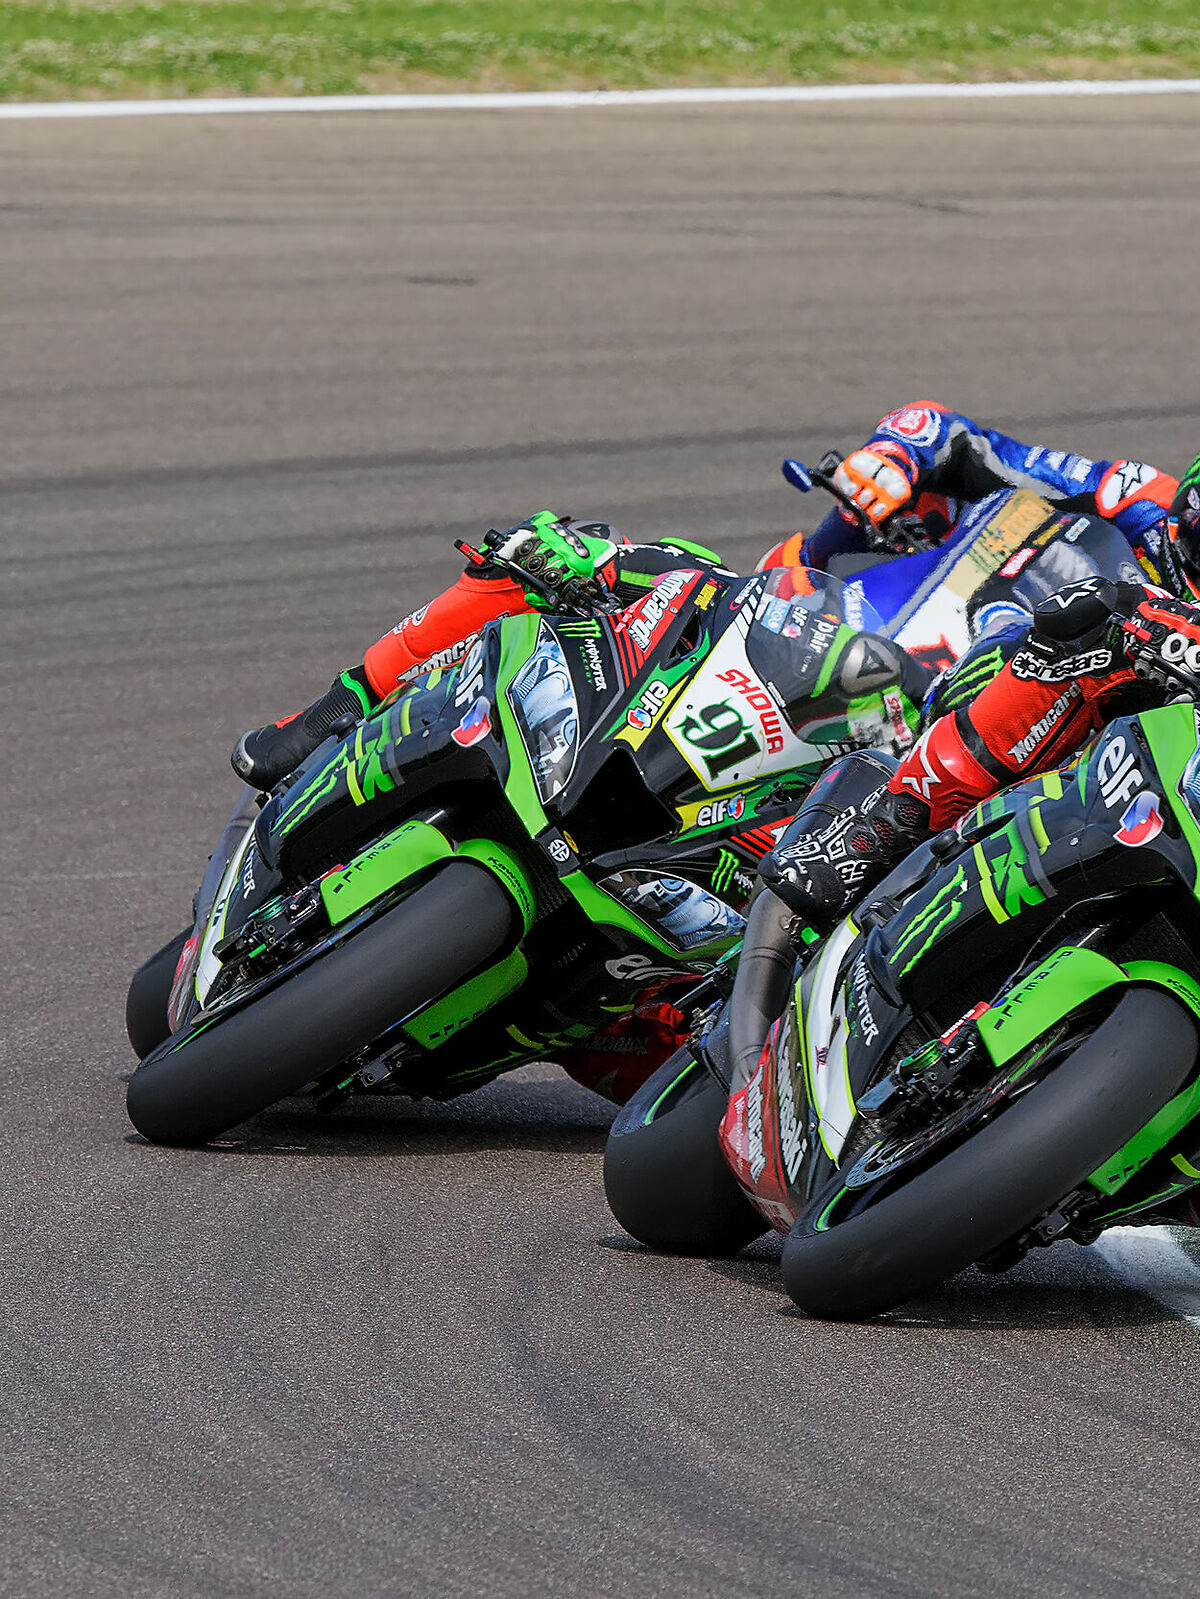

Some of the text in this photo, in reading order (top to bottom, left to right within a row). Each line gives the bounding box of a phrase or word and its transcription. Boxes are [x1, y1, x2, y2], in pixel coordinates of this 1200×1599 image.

[639, 679, 670, 718] elf
[715, 669, 784, 754] SHOWA
[673, 697, 763, 781] 91
[1098, 736, 1144, 808] elf
[696, 803, 728, 828] elf
[333, 824, 416, 894] PIRELLI
[994, 950, 1073, 1031] PIRELLI
